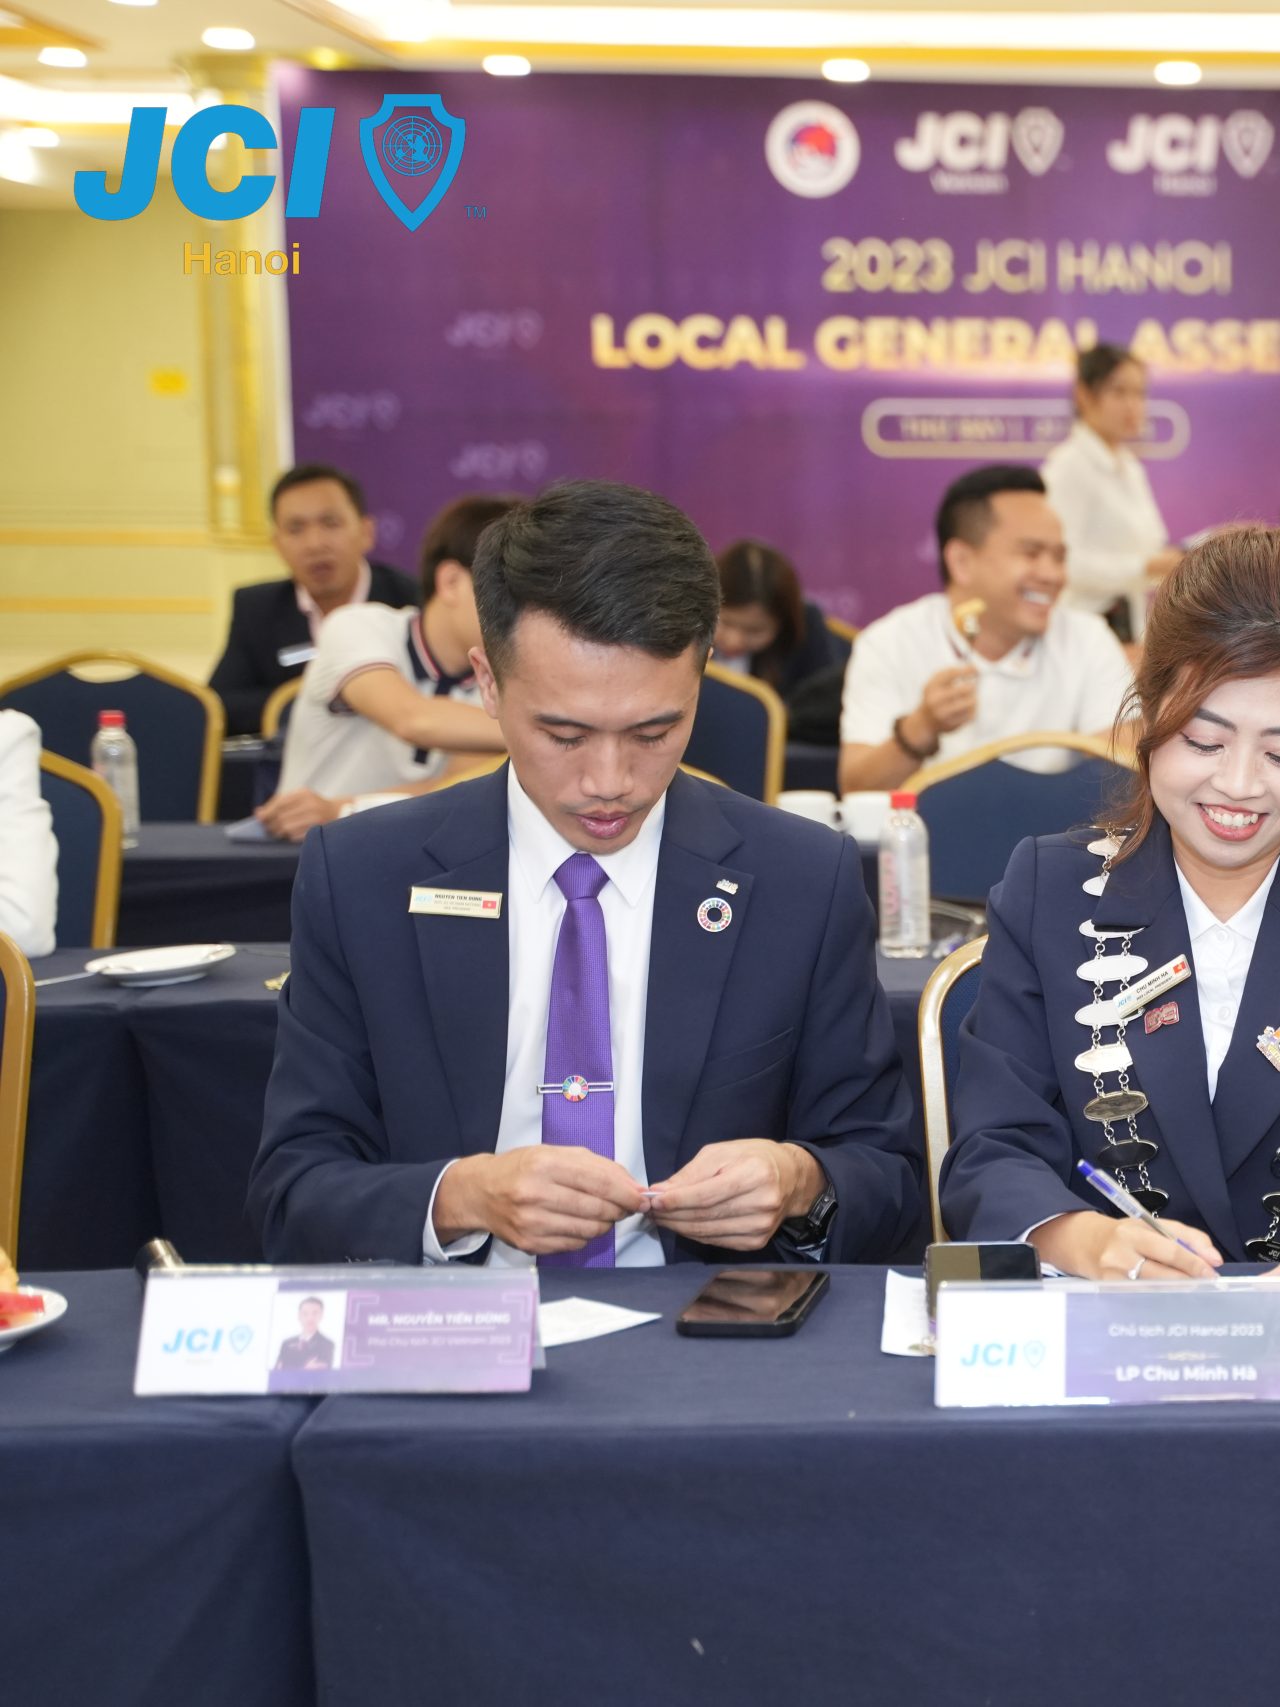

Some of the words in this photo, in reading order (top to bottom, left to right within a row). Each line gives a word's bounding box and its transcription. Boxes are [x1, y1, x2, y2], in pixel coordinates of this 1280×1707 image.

[894, 111, 1010, 172] JCI
[1106, 113, 1222, 174] JCI
[821, 237, 954, 294] 2023
[962, 238, 1046, 294] JCI
[1057, 239, 1232, 296] HANOI
[590, 312, 806, 371] LOCAL
[1136, 984, 1148, 994] CHU
[1148, 975, 1160, 986] MINH
[162, 1327, 224, 1353] JCI
[1167, 1323, 1188, 1337] JCI
[1190, 1323, 1228, 1337] Hanoi
[1230, 1323, 1264, 1337] 2023
[960, 1342, 1018, 1367] JCI
[1116, 1365, 1140, 1382] LP
[1143, 1364, 1180, 1382] Chu
[1183, 1364, 1229, 1381] Minh
